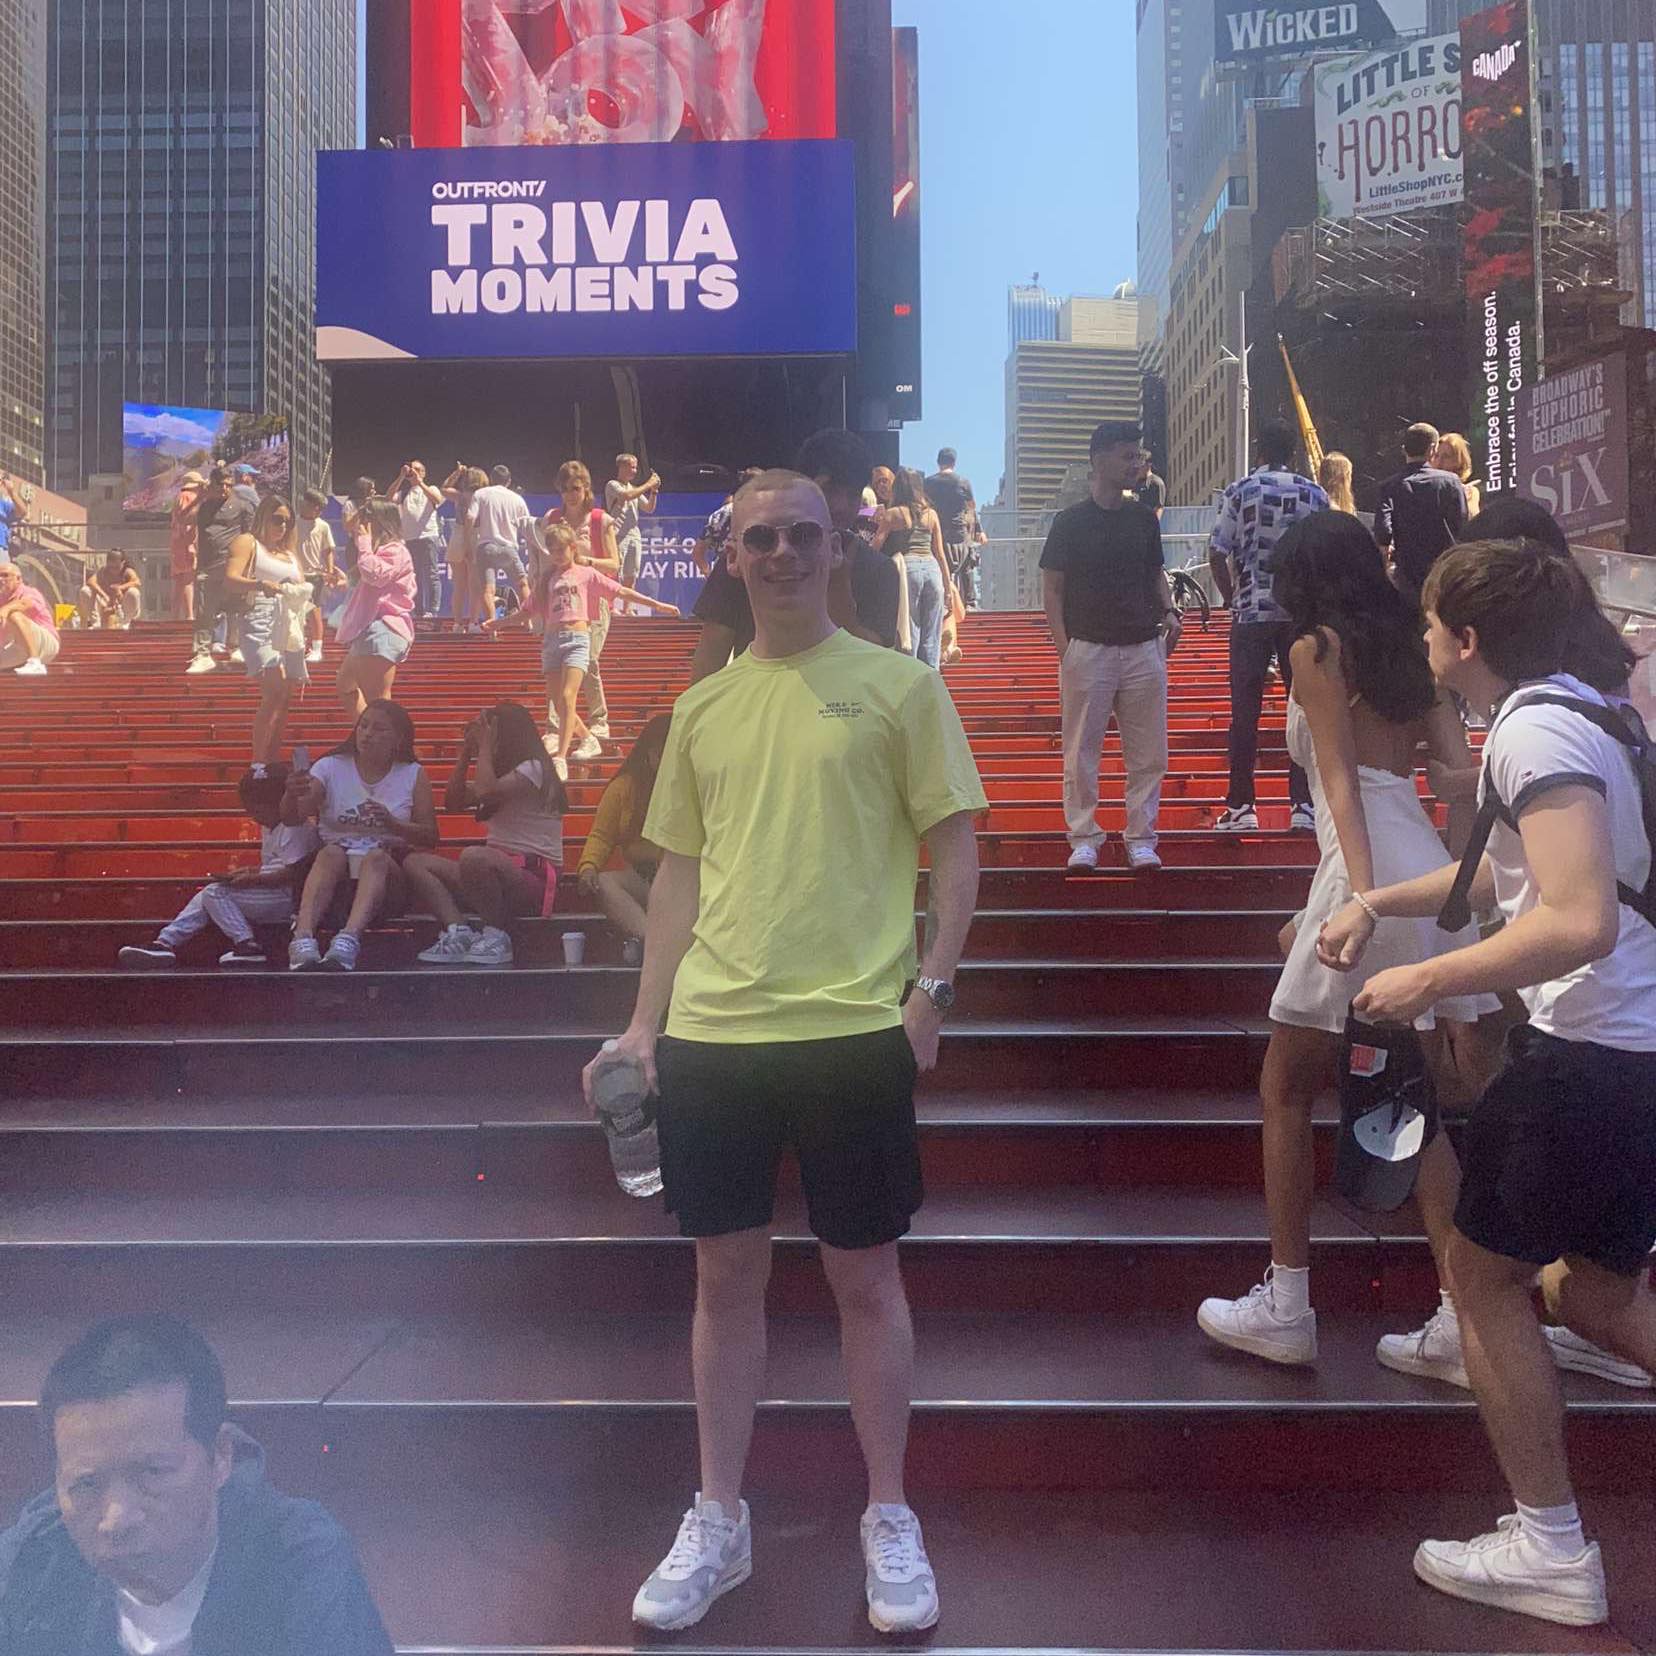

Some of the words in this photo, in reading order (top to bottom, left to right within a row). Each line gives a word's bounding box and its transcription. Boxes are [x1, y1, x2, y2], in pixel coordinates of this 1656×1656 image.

[1337, 46, 1435, 116] LITTLE
[1472, 44, 1516, 81] CANADA
[1411, 85, 1430, 98] OF
[1394, 196, 1427, 208] Theatre
[432, 198, 738, 266] TRIVIA
[431, 263, 739, 314] MOMENTS
[1483, 290, 1499, 357] season.
[1483, 360, 1498, 383] off
[1506, 320, 1522, 392] Canada.
[1484, 385, 1500, 414] the
[1532, 363, 1603, 406] BROADWAY'S
[1485, 416, 1502, 492] Embrace
[1530, 447, 1612, 516] SIX
